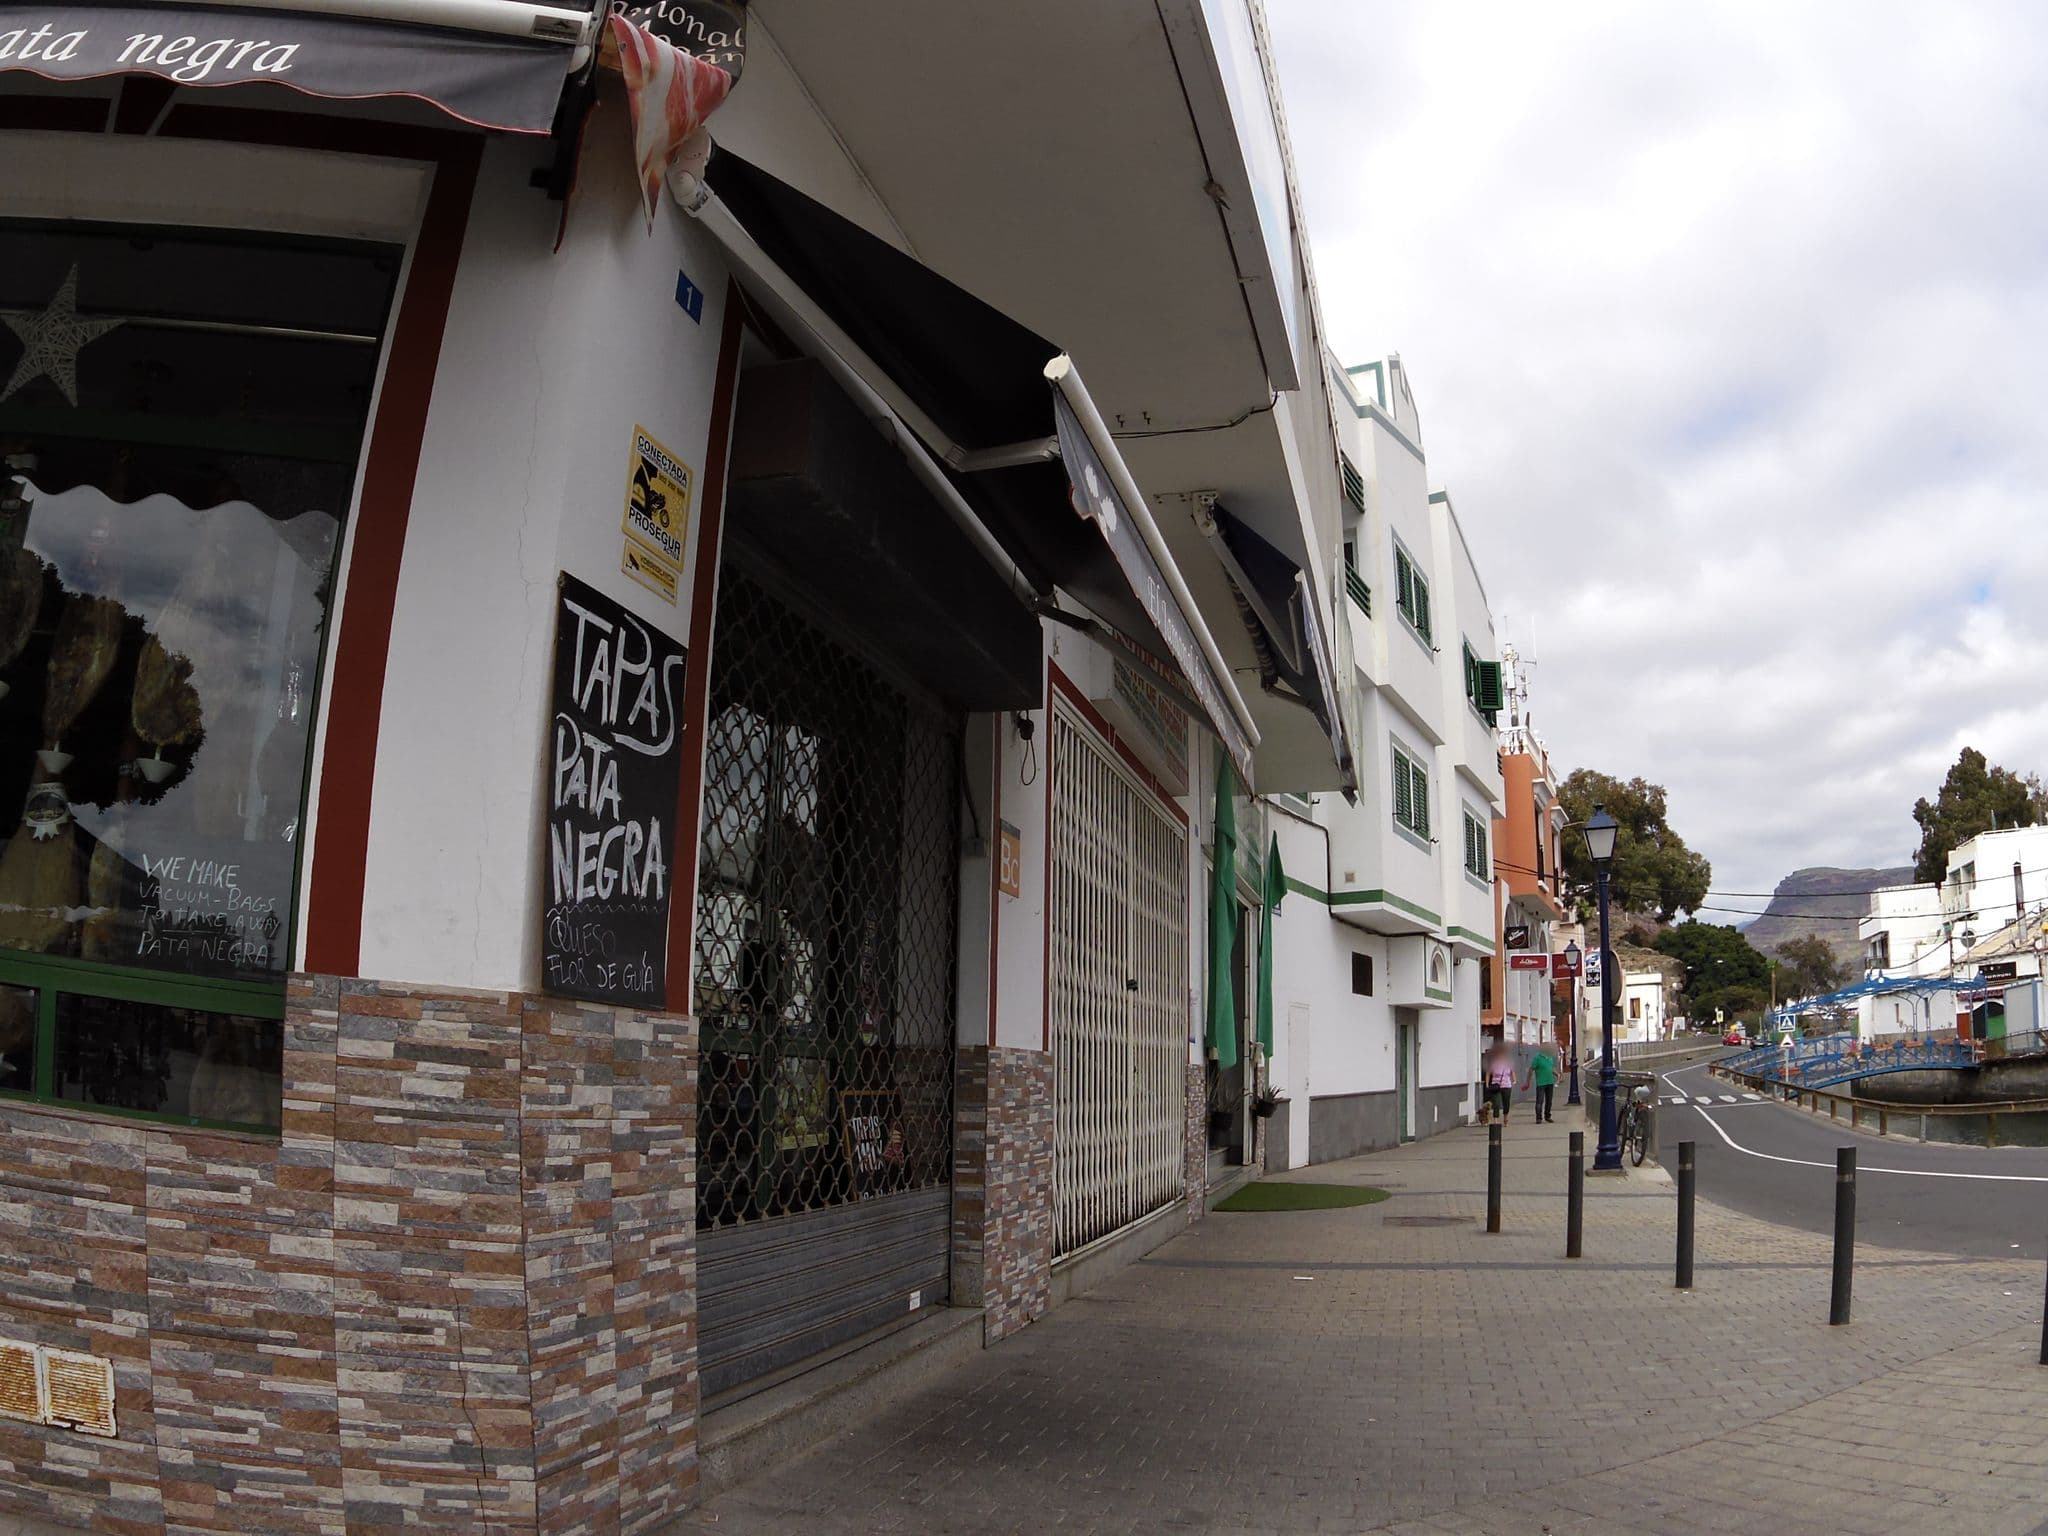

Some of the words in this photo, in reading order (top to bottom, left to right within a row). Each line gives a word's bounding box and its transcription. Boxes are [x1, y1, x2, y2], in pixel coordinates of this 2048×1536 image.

[0, 22, 88, 62] ata
[116, 32, 301, 81] negra
[683, 285, 694, 312] 1
[637, 435, 688, 482] CONECTADA
[628, 507, 681, 554] PROSEGUR
[562, 597, 684, 757] TAPAS
[555, 711, 622, 822] PATA
[142, 853, 186, 881] WE
[187, 859, 240, 888] MAKE
[550, 815, 667, 905] NEGRA
[137, 931, 191, 957] PATA
[201, 937, 269, 965] NEGRA
[547, 953, 588, 989] FLOR
[597, 963, 616, 990] DE
